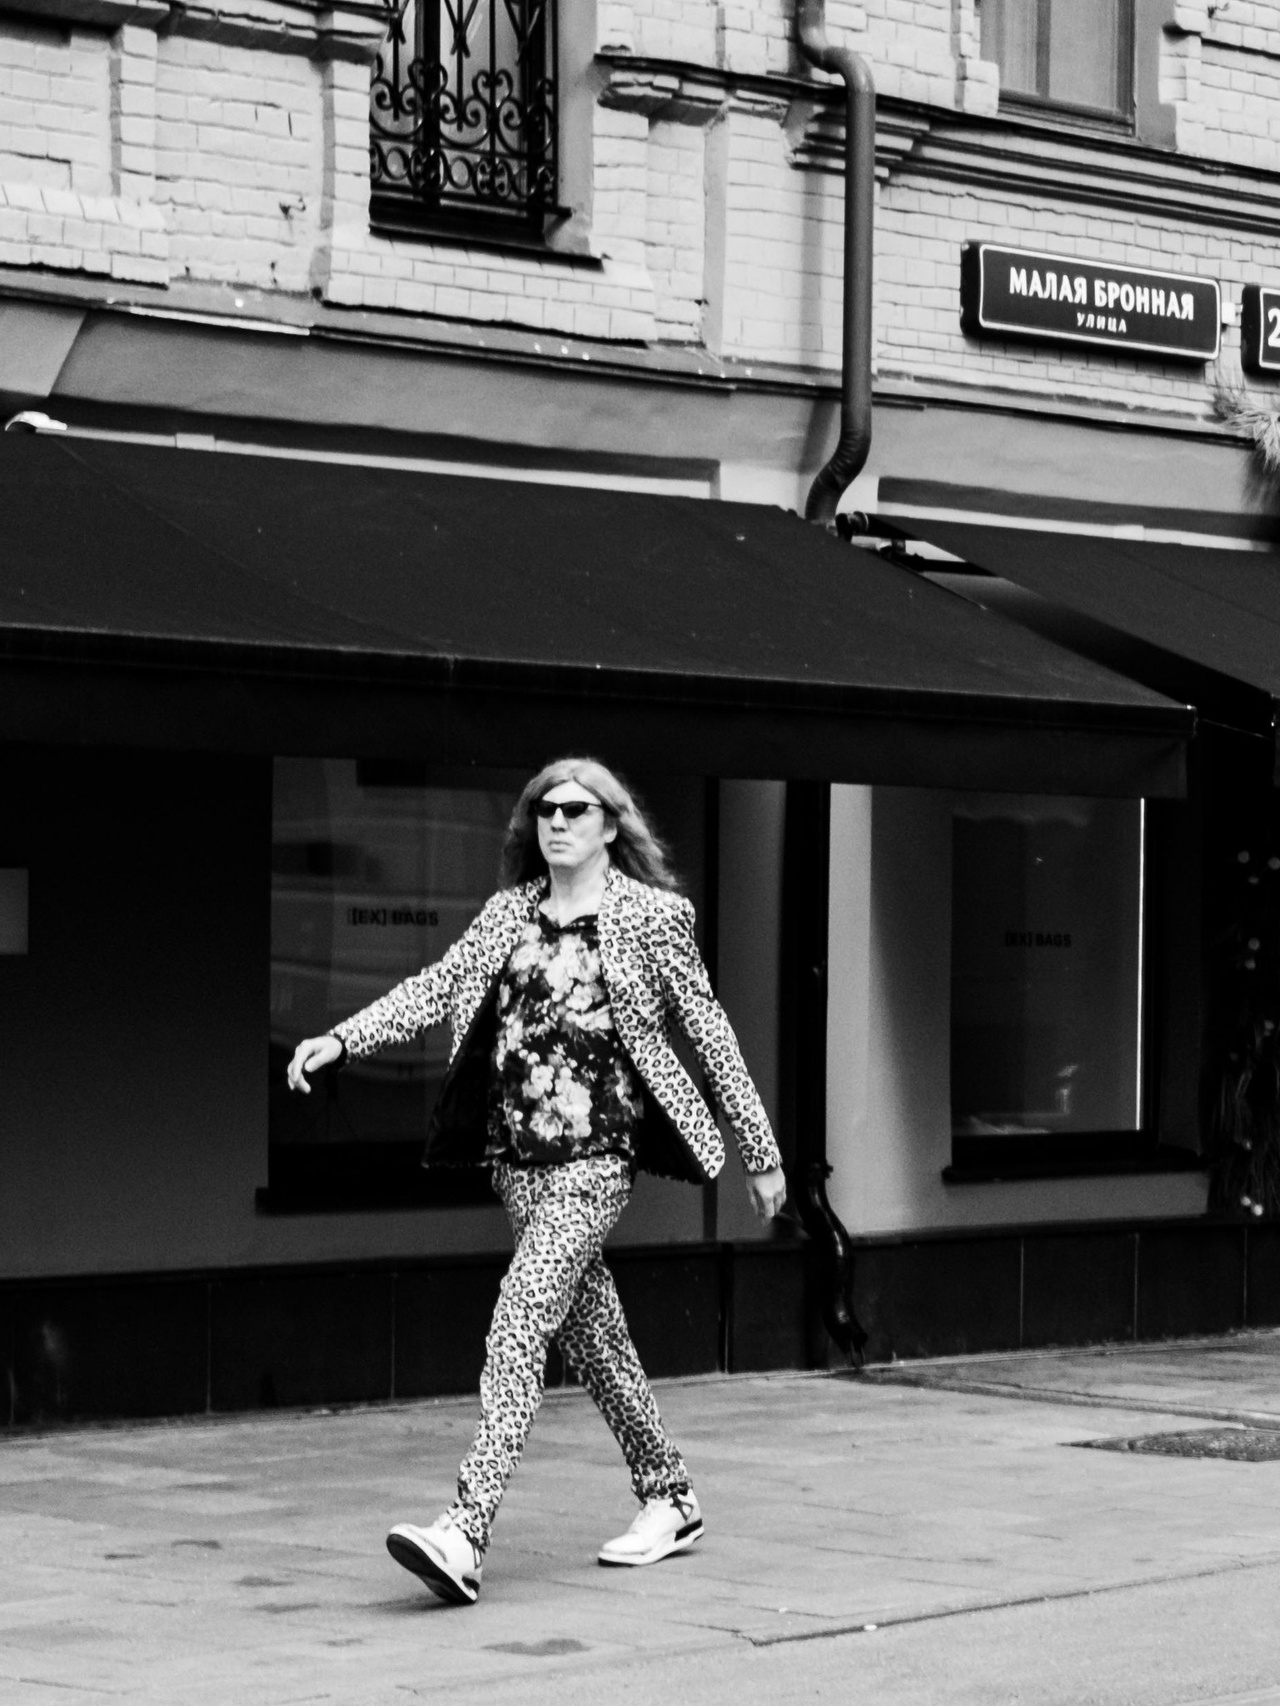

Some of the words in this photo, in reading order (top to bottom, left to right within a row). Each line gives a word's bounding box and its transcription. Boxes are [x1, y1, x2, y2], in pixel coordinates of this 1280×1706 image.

[1009, 266, 1087, 304] МАЛАЯ
[1095, 279, 1194, 321] БРОННАЯ
[1077, 312, 1127, 333] УЛИЦА
[392, 909, 439, 926] BAGS
[1035, 932, 1072, 948] BAGS
